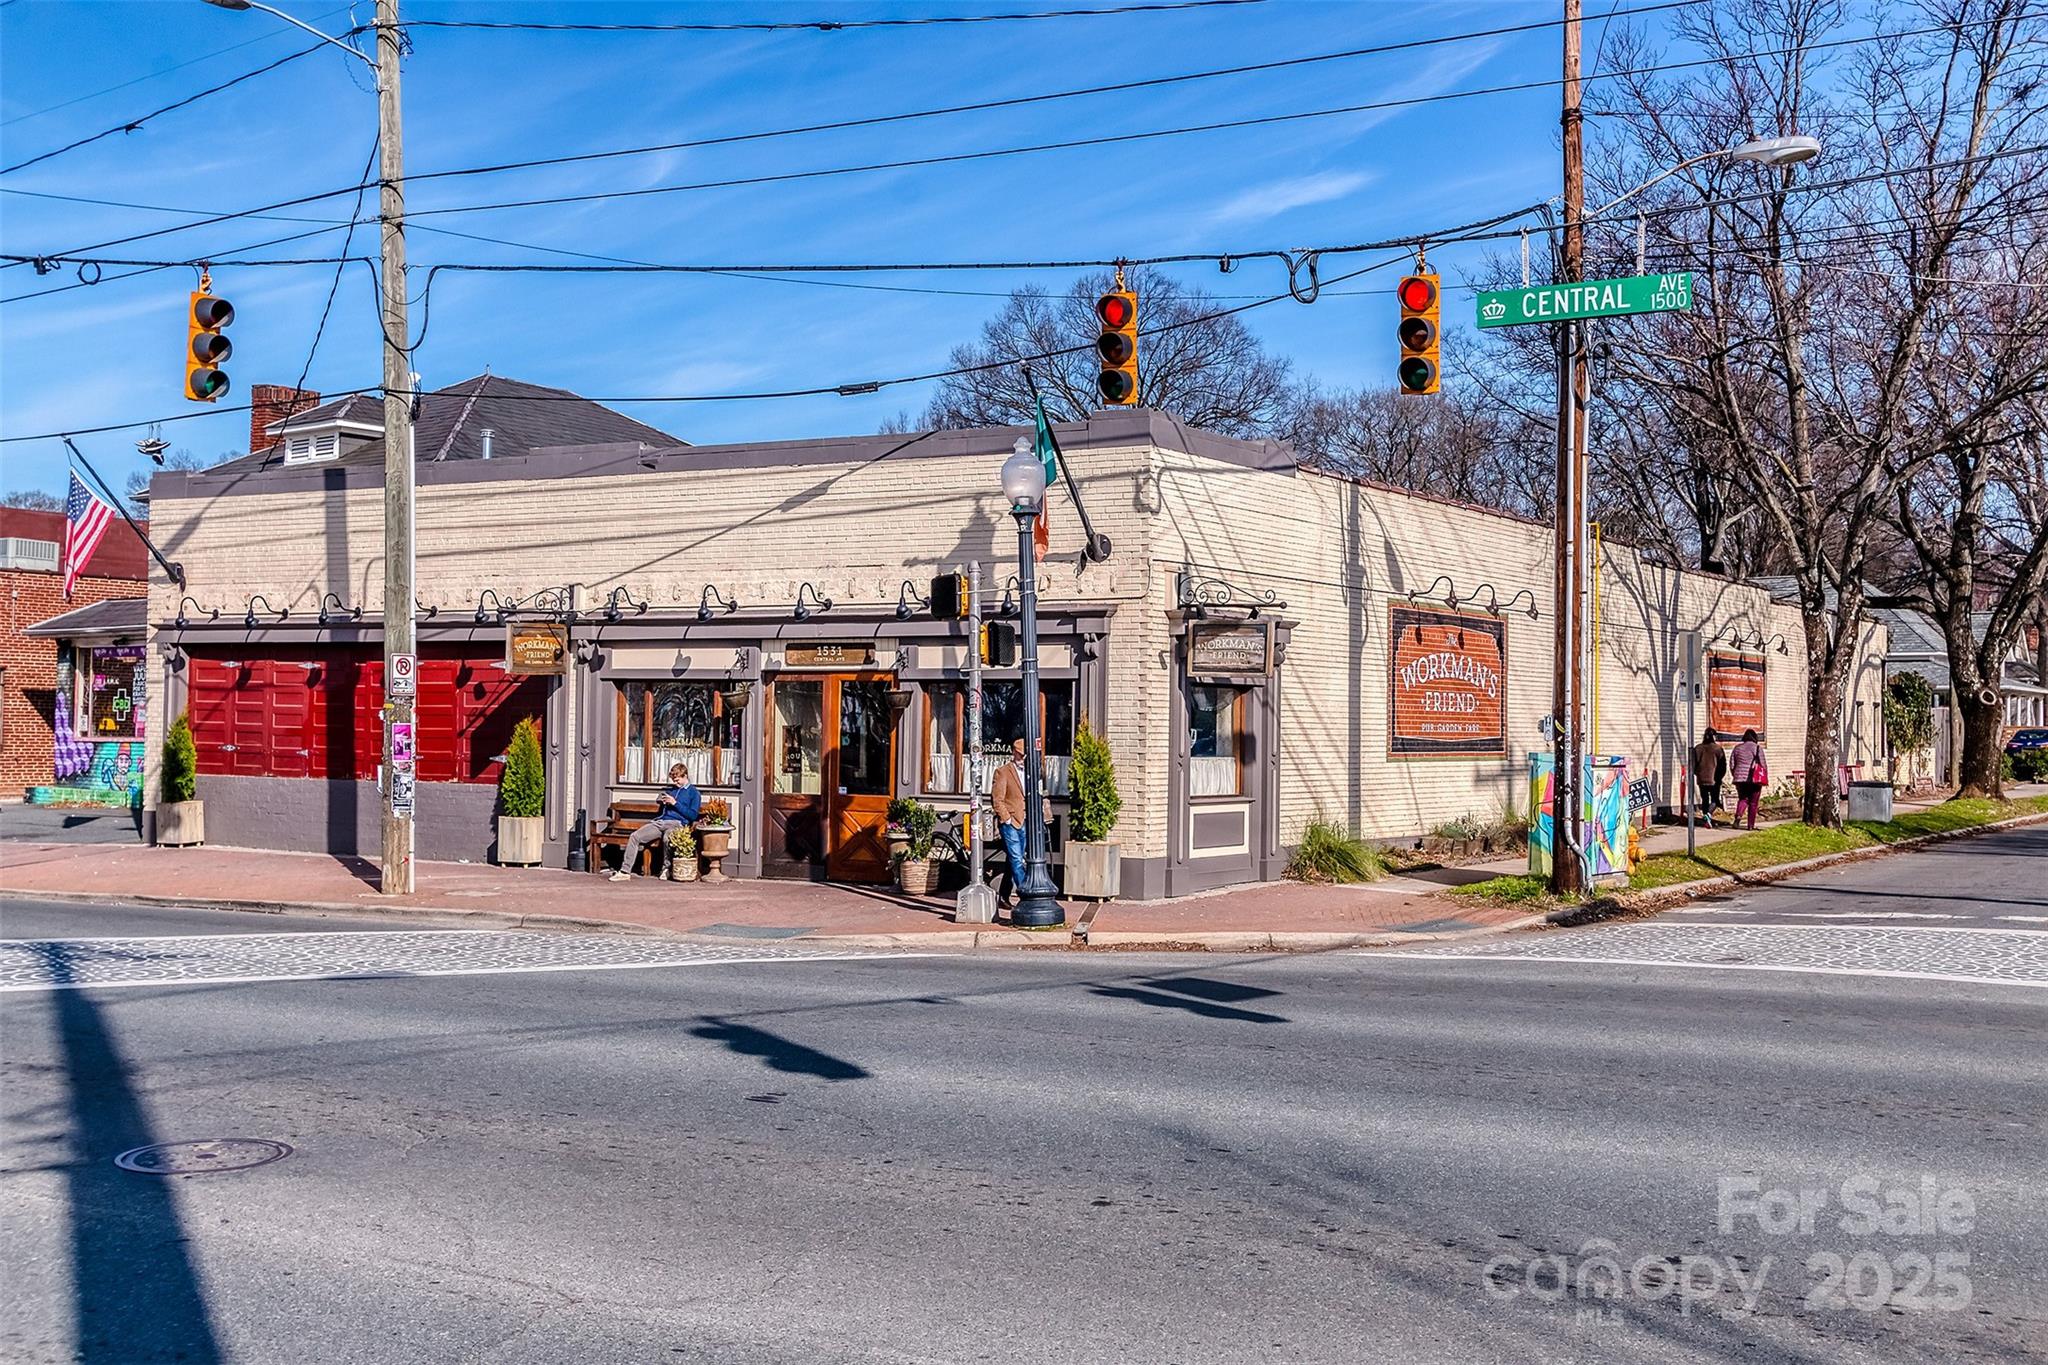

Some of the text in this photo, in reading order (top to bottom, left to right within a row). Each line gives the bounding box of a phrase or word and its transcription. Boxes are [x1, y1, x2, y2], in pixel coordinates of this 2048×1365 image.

[1522, 274, 1687, 318] CENTRAL AVE
[1651, 290, 1687, 309] 1500
[515, 640, 561, 652] WORKMAN'S
[816, 646, 843, 656] 1531
[1196, 639, 1263, 653] WORKMAN'S
[1212, 650, 1247, 660] FRIEND
[1400, 652, 1498, 698] WORKMAN'S
[113, 699, 130, 710] CBD
[1424, 691, 1476, 713] FRIEND
[1630, 782, 1645, 792] ALI
[1629, 788, 1647, 798] OGA
[1629, 795, 1649, 806] ODA
